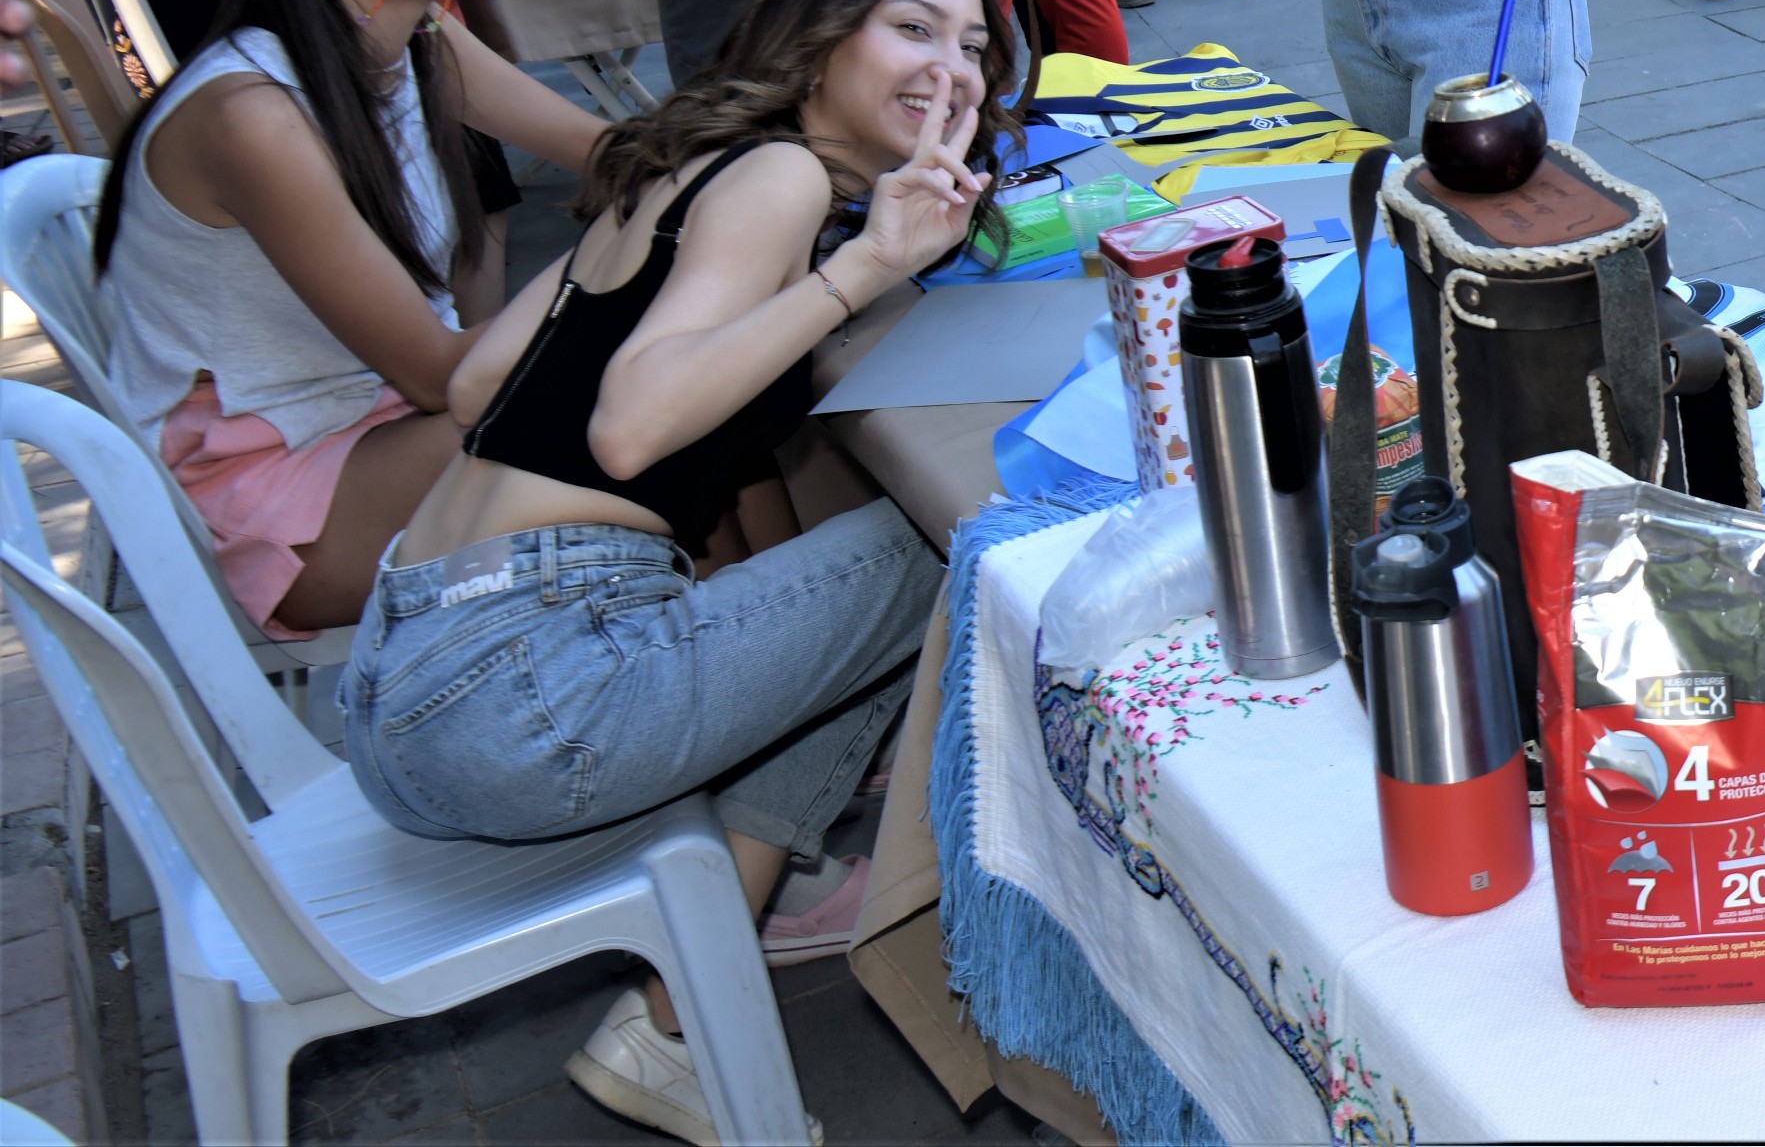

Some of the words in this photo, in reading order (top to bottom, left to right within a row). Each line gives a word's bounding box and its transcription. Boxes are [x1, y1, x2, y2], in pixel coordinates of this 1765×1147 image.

[440, 562, 513, 608] mavi
[1674, 745, 1715, 802] 4
[1718, 774, 1757, 789] CAPAS
[1627, 878, 1656, 911] 7
[1613, 942, 1625, 952] En
[1626, 944, 1642, 954] Las
[1675, 943, 1719, 953] cuidamos
[1720, 942, 1729, 951] lo
[1730, 942, 1748, 952] que
[1638, 955, 1645, 964] Y
[1645, 955, 1655, 964] lo
[1656, 953, 1709, 965] protegemos
[1711, 951, 1728, 960] con
[1729, 950, 1739, 959] lo
